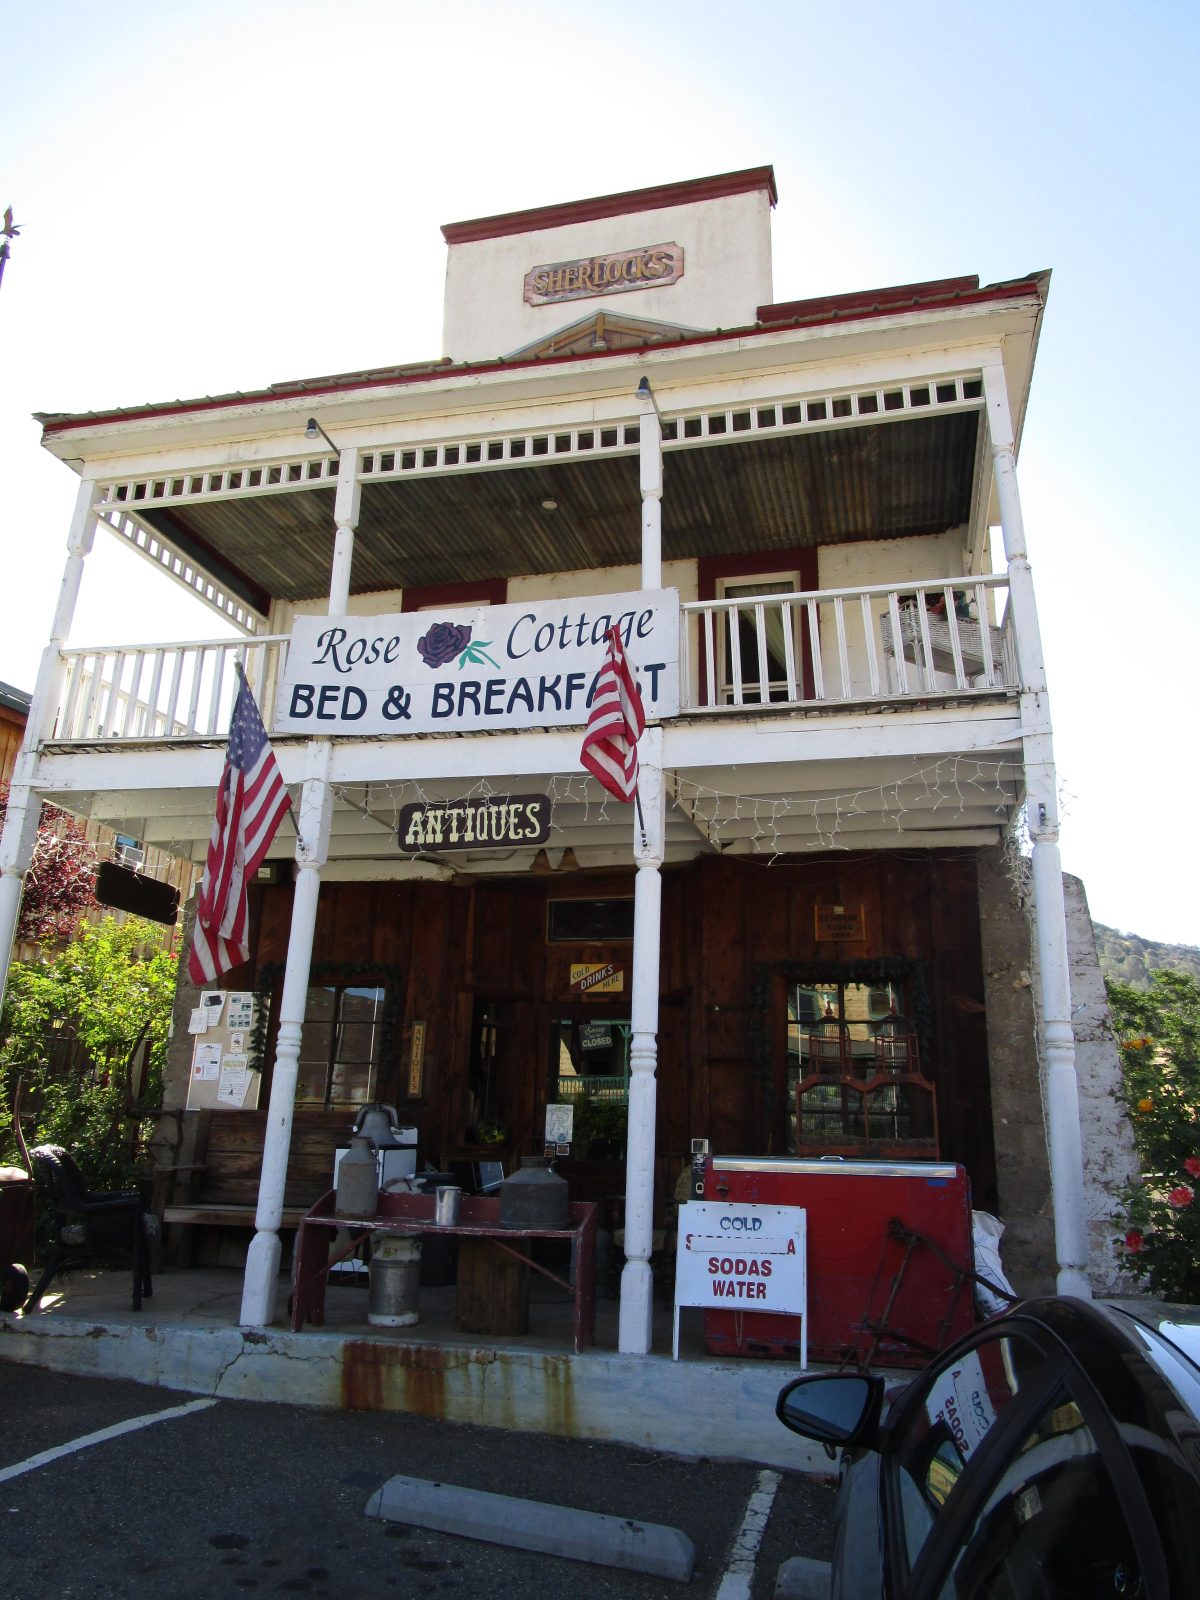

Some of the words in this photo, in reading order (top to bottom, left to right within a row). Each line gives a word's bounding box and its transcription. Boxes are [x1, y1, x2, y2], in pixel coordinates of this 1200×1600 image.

[311, 627, 401, 673] Rose
[506, 609, 654, 660] Cottage
[289, 683, 368, 721] BED
[381, 685, 412, 721] &
[405, 802, 541, 845] ANTIQUES
[572, 965, 590, 980] COLD
[581, 964, 613, 990] DRINKS
[602, 974, 619, 990] HERE
[582, 1037, 612, 1048] CLOSED
[411, 1028, 422, 1092] ANTIQUES
[719, 1216, 762, 1231] COLD
[708, 1257, 772, 1277] SODAS
[712, 1280, 767, 1300] WATER
